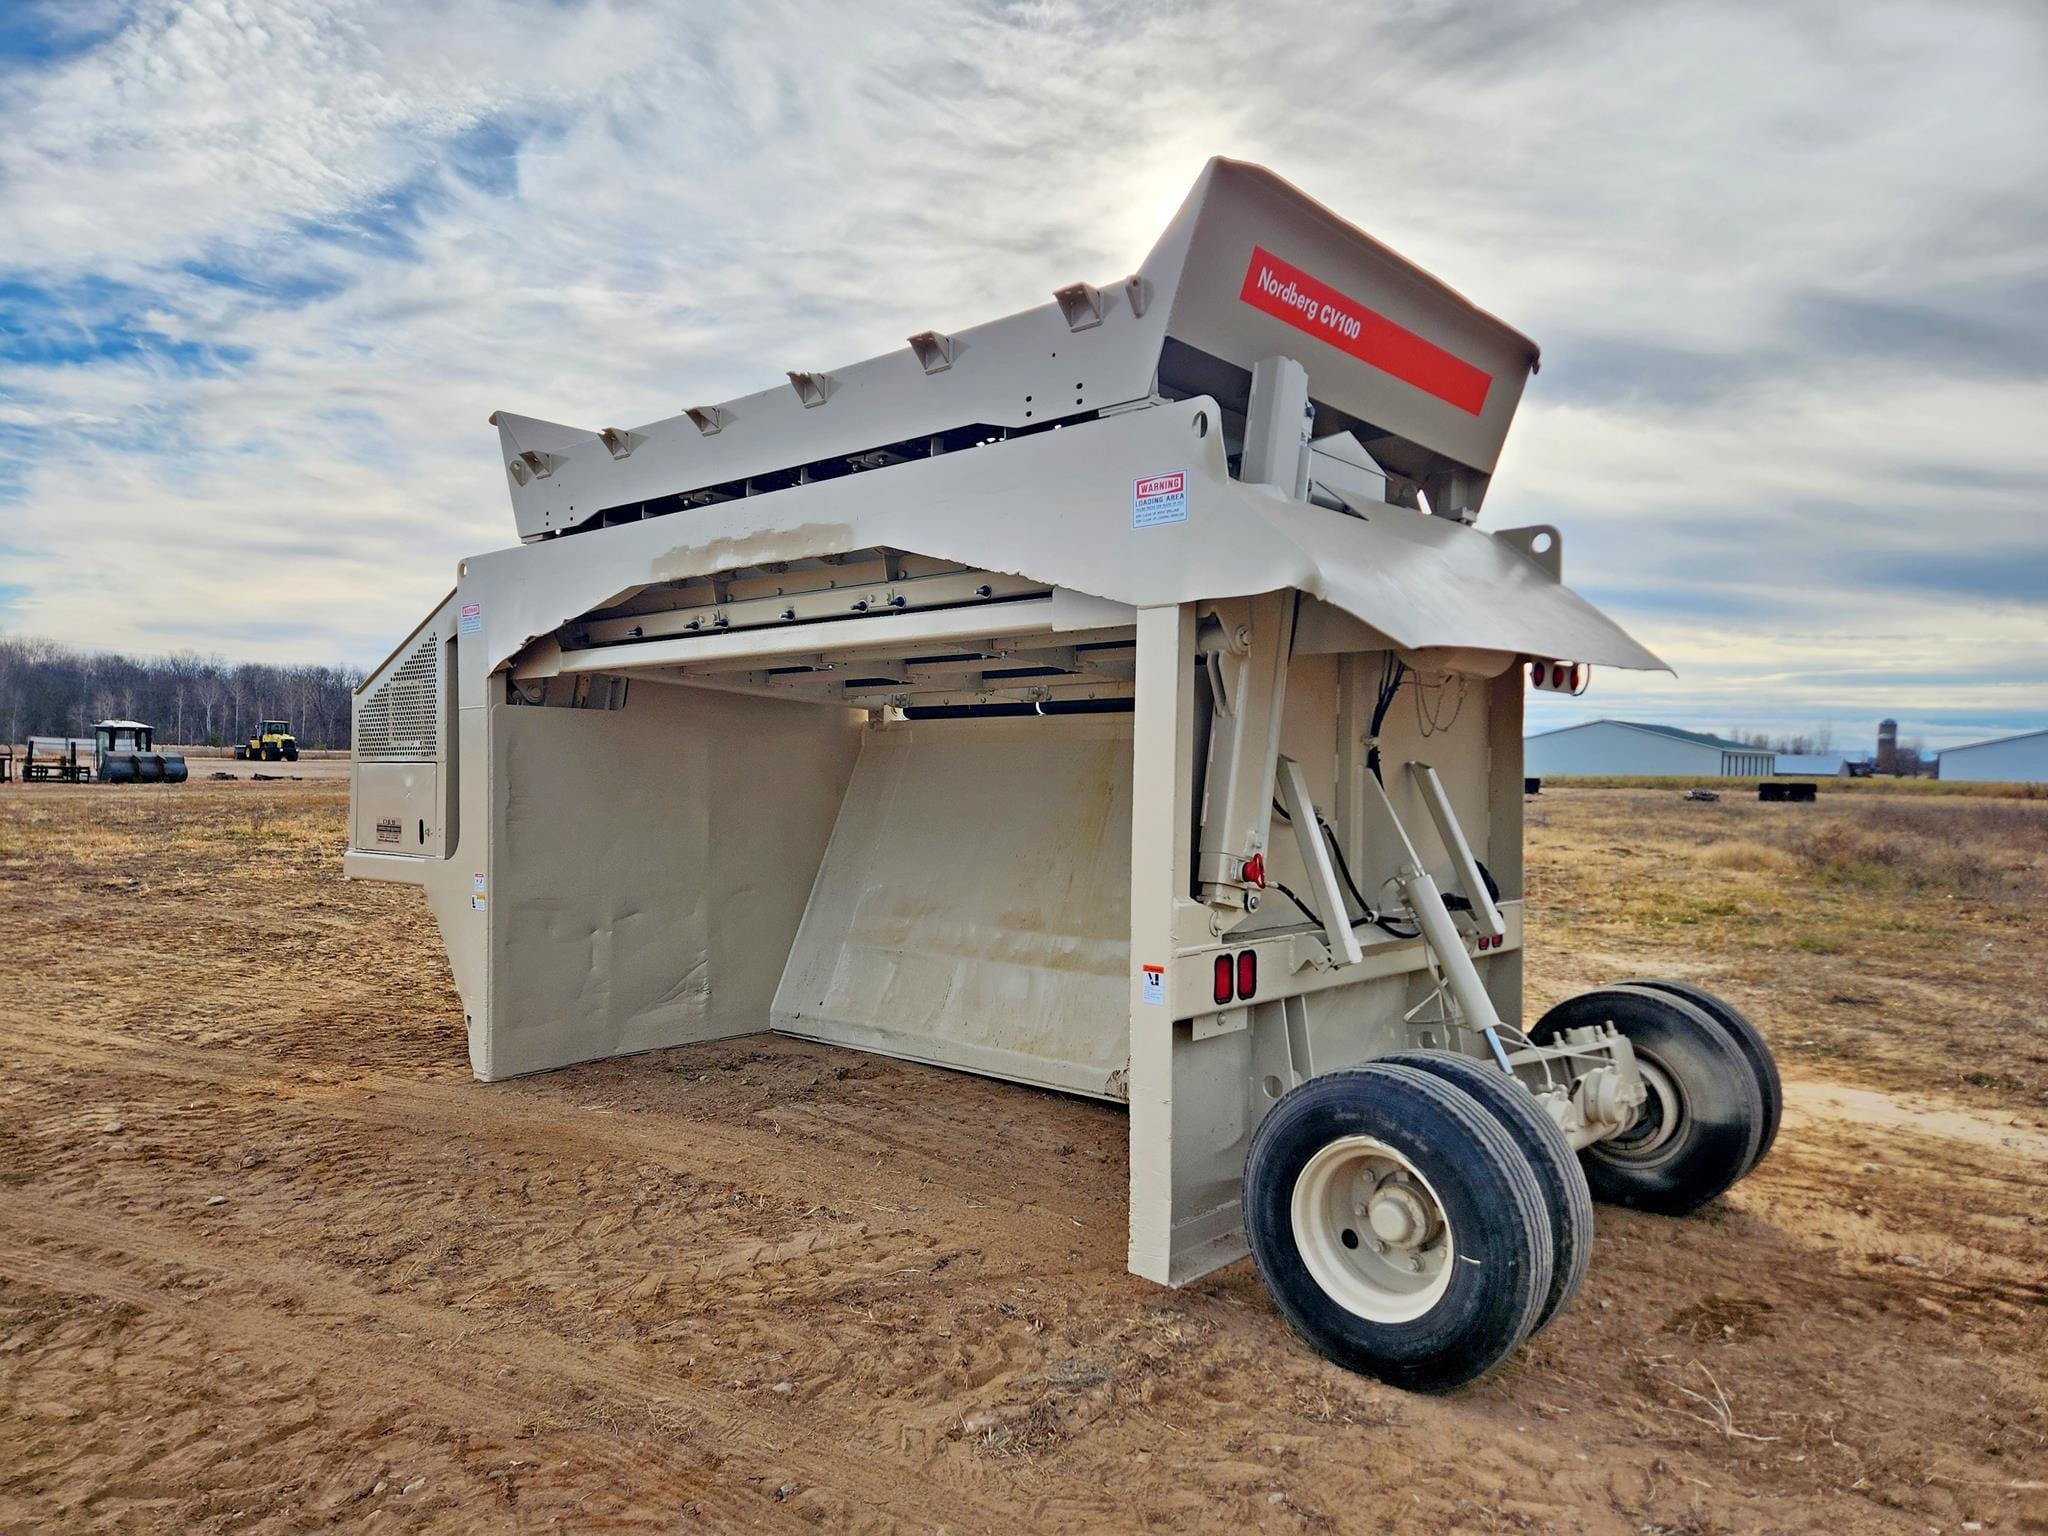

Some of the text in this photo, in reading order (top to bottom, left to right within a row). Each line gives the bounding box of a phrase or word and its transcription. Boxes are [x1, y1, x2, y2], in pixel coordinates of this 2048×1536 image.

[1257, 266, 1361, 340] Nordberg CV100
[1141, 479, 1179, 493] WARNING
[1136, 497, 1163, 507] LOADING
[1166, 493, 1184, 501] AREA
